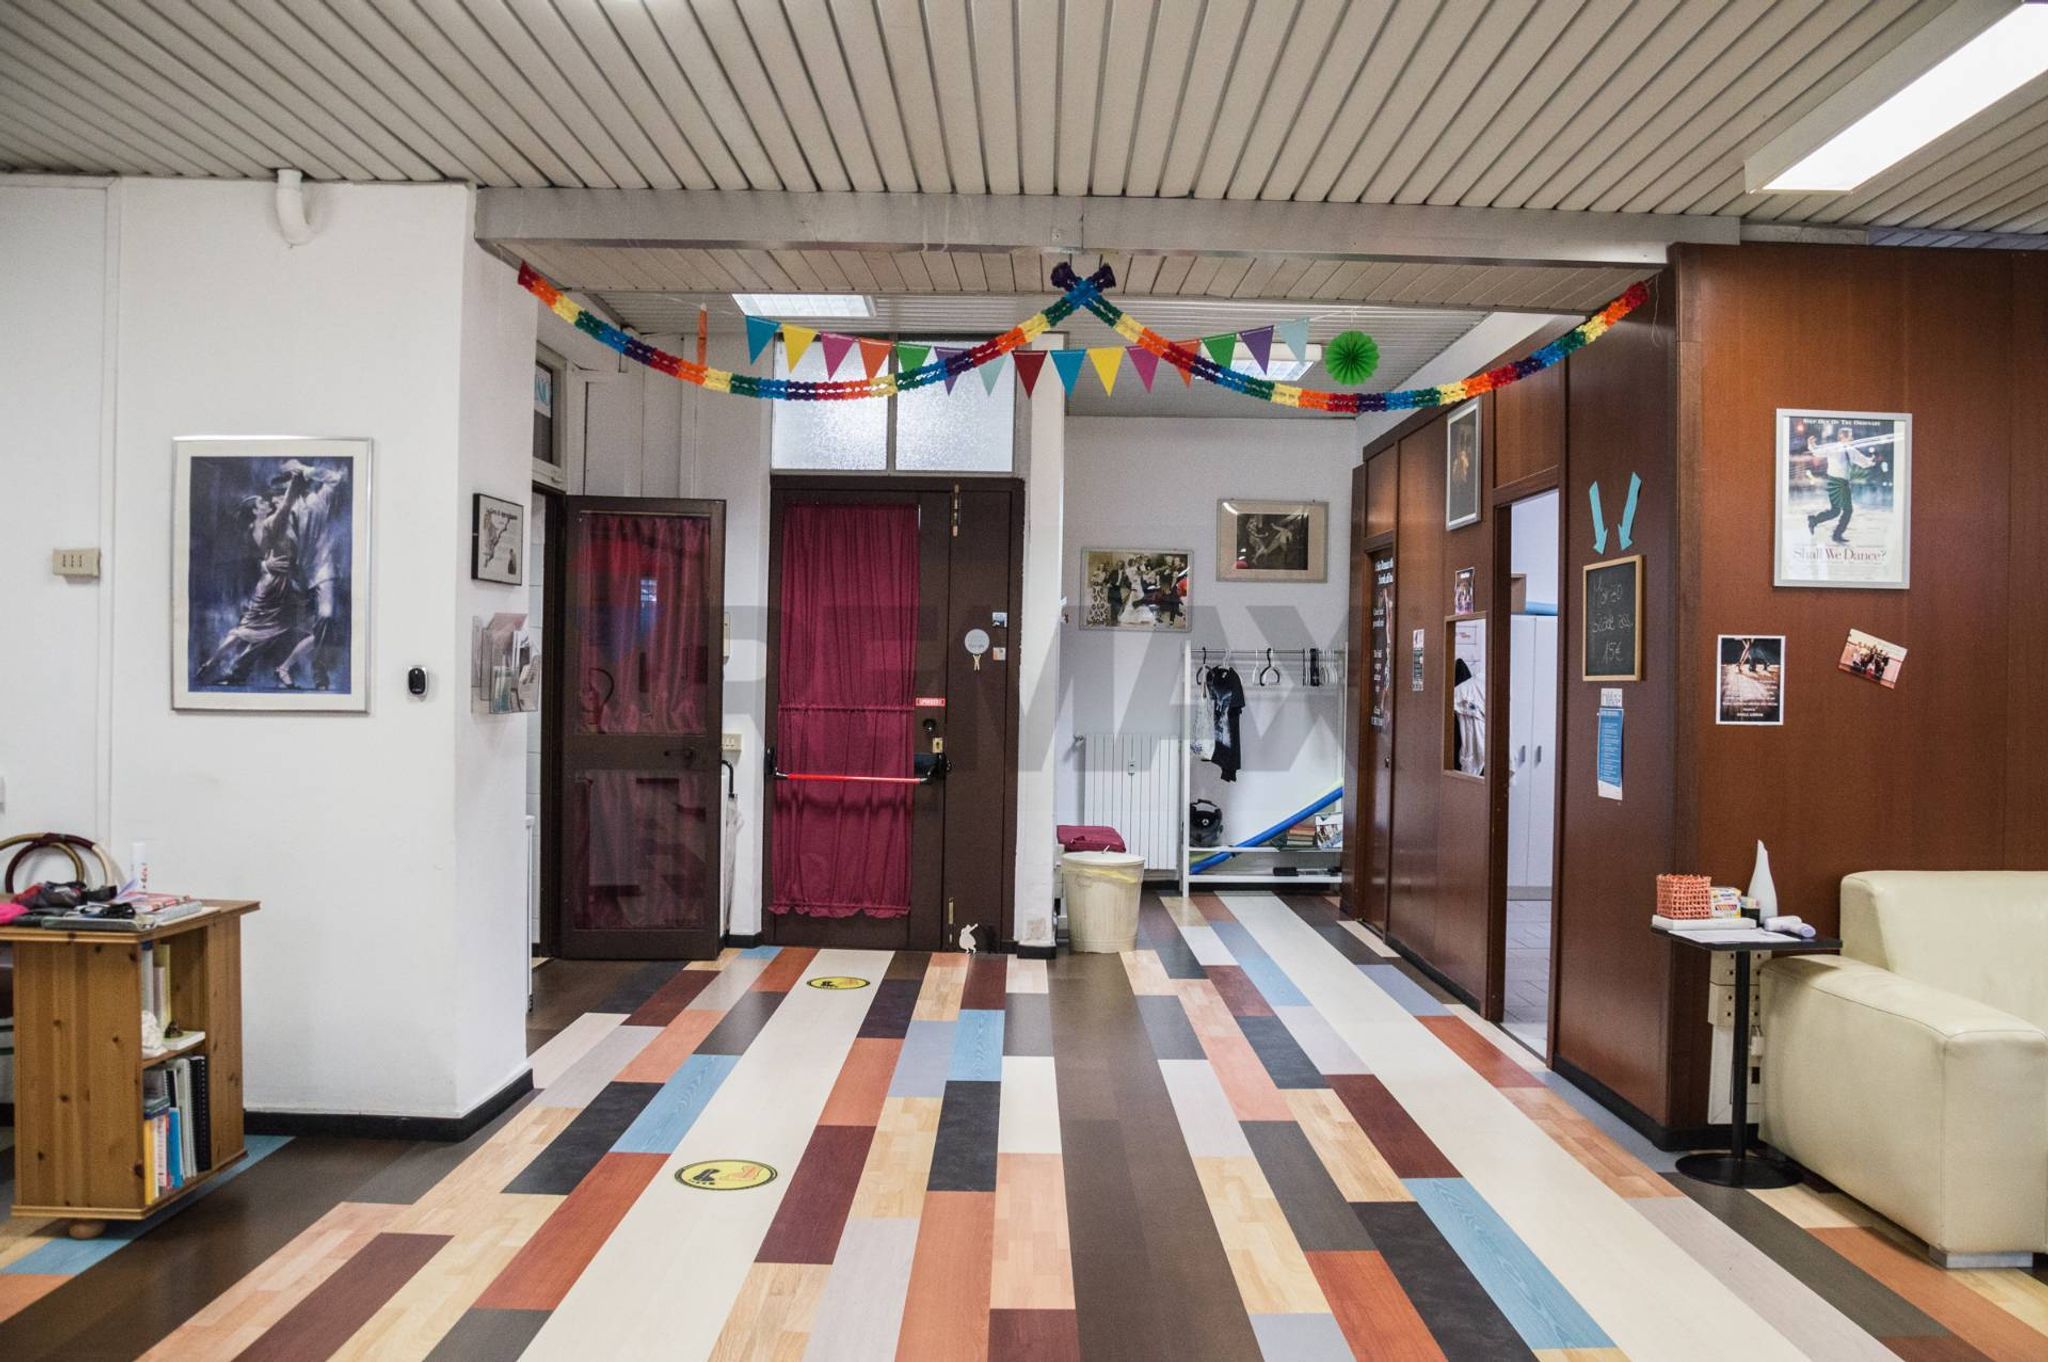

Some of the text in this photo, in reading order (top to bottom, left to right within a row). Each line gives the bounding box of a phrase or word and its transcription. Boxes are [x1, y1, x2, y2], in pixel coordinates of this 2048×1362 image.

[1793, 547, 1887, 561] Shall We Dance?
